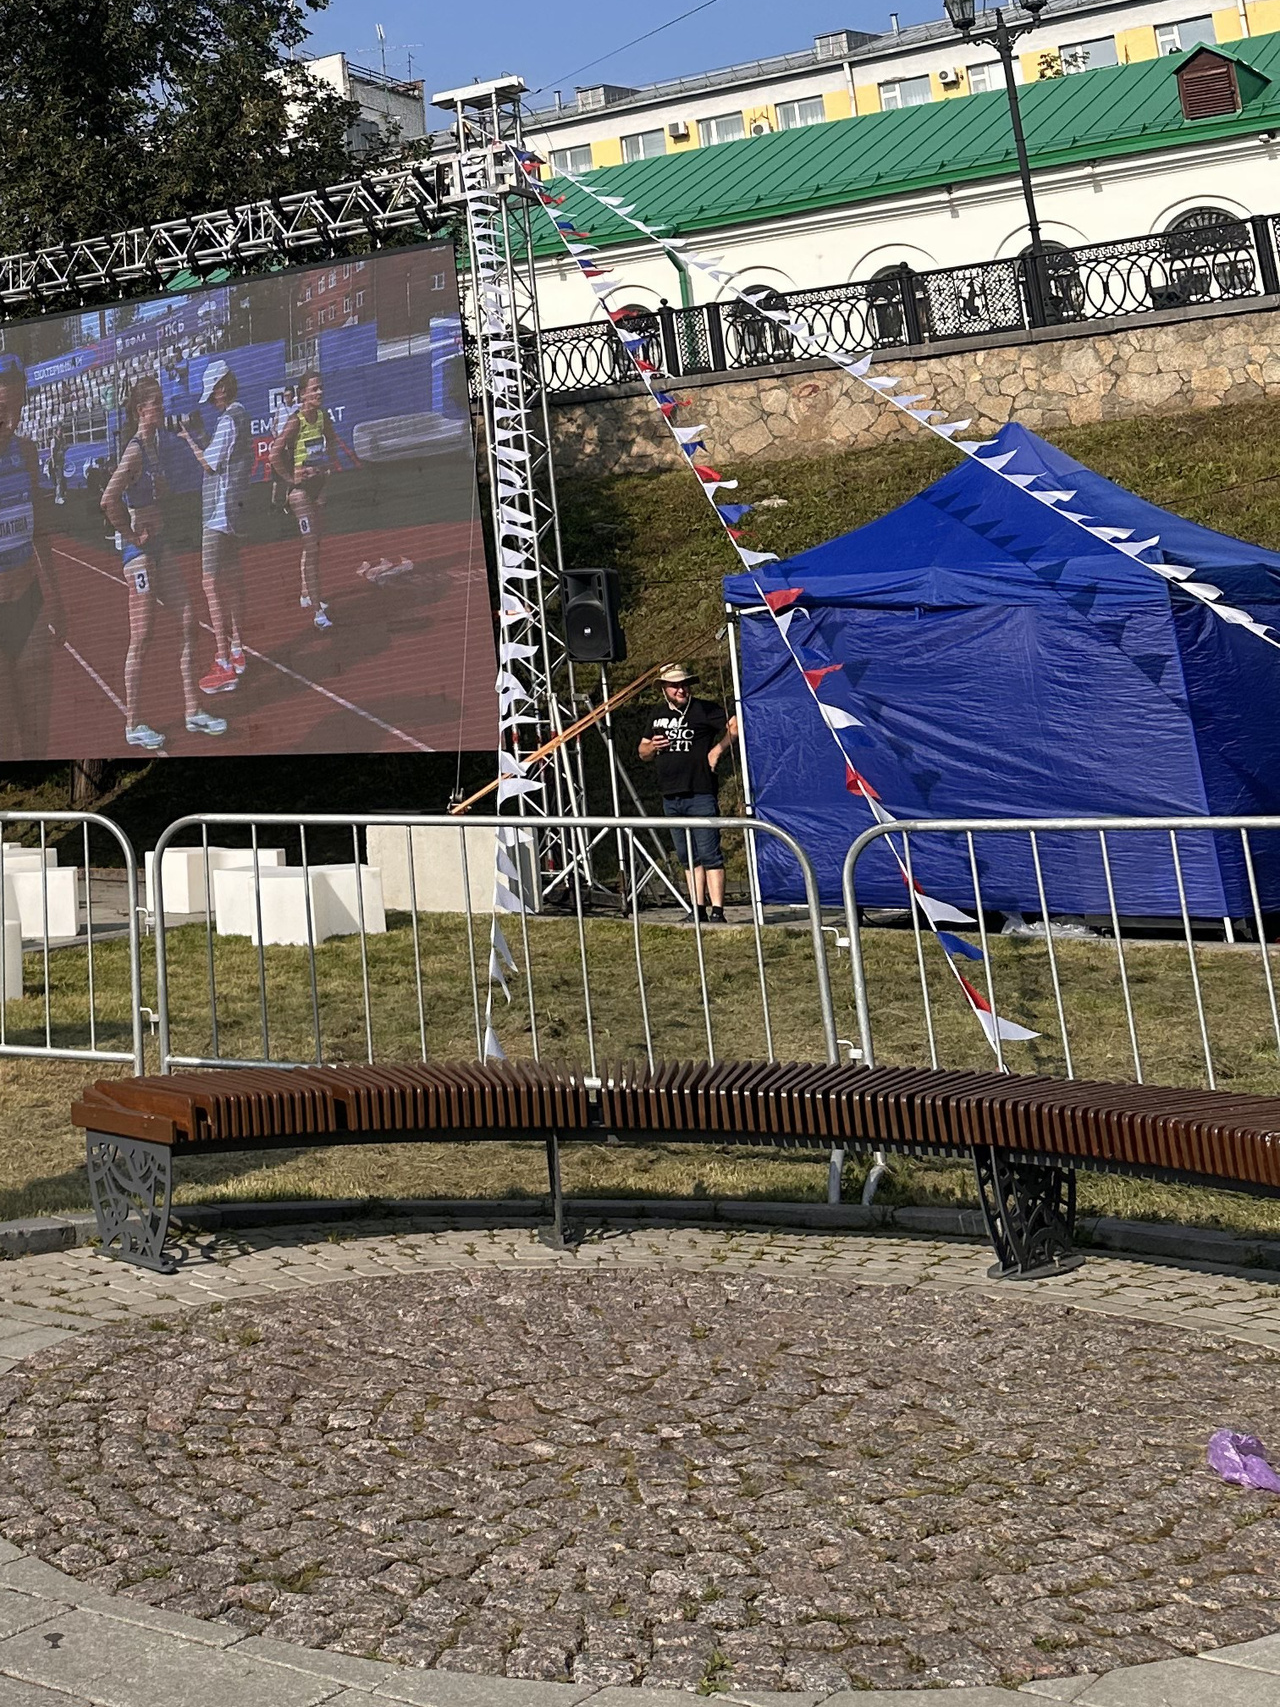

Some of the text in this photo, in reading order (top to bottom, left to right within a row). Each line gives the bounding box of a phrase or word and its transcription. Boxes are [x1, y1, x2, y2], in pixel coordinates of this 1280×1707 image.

[33, 354, 84, 380] ЕКАТЕРИНБРГ
[137, 573, 146, 589] 3
[665, 728, 695, 740] SIC
